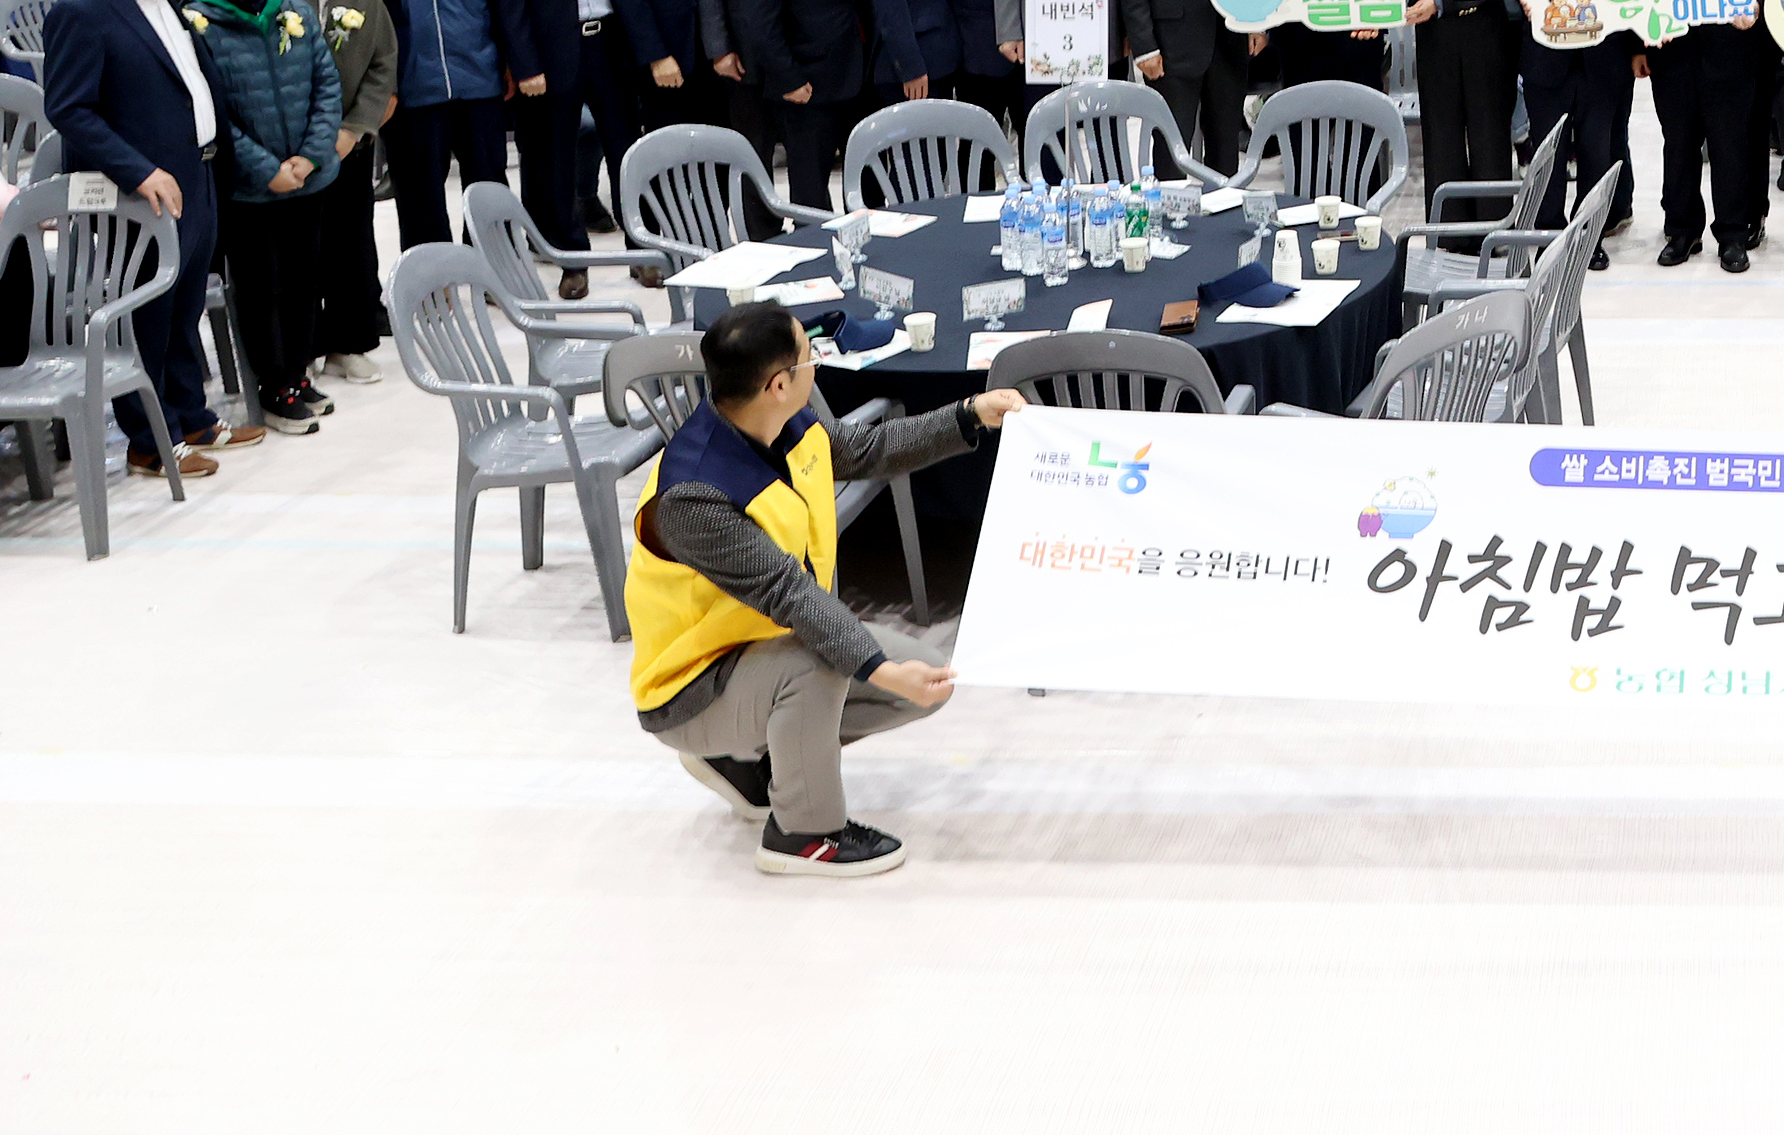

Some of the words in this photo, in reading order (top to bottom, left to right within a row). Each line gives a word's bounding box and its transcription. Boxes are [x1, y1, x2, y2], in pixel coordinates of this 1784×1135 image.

[1042, 2, 1094, 21] 내빈석
[1062, 33, 1074, 51] 3
[1561, 455, 1588, 484] 쌀
[1594, 455, 1699, 486] 소비촉진
[1704, 457, 1782, 489] 범국민
[1018, 538, 1166, 577] 대한민국을
[1175, 548, 1332, 584] 응원합니다!
[1366, 533, 1645, 642] 아침밥
[1614, 666, 1687, 695] 농협
